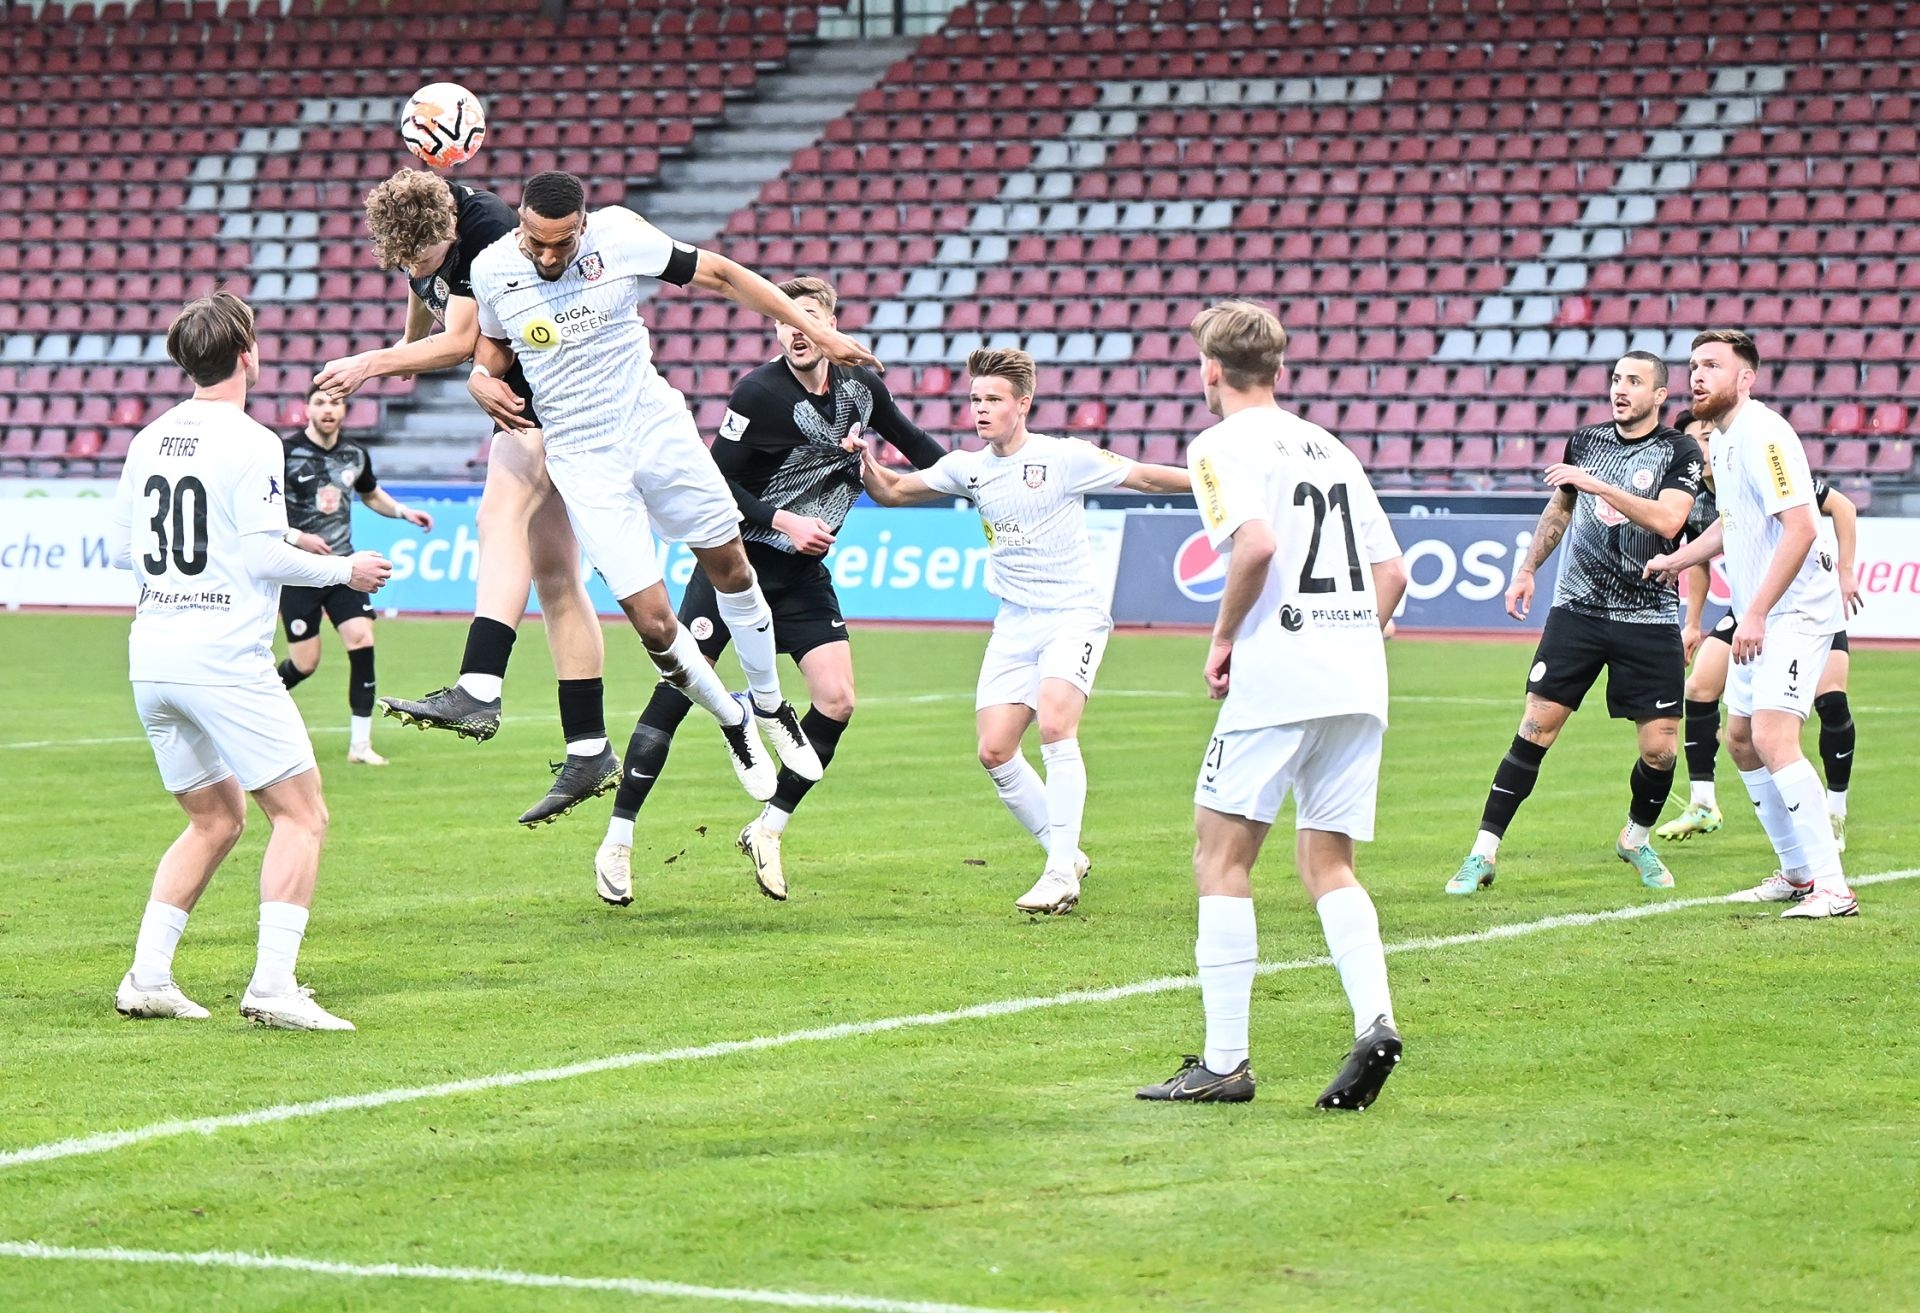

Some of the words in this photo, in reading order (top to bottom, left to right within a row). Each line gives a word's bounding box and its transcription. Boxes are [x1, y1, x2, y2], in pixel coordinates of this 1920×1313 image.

[554, 305, 596, 325] GIGA.
[560, 313, 609, 338] GREEN
[159, 436, 199, 457] PETERS
[143, 474, 208, 576] 30
[1293, 481, 1365, 594] 21
[827, 530, 991, 590] eisen
[201, 592, 231, 605] HERZ
[1312, 609, 1350, 621] PFLEGE
[1353, 609, 1372, 621] MIT
[1081, 641, 1093, 665] 3
[1788, 659, 1799, 681] 4
[1206, 736, 1225, 770] 21
